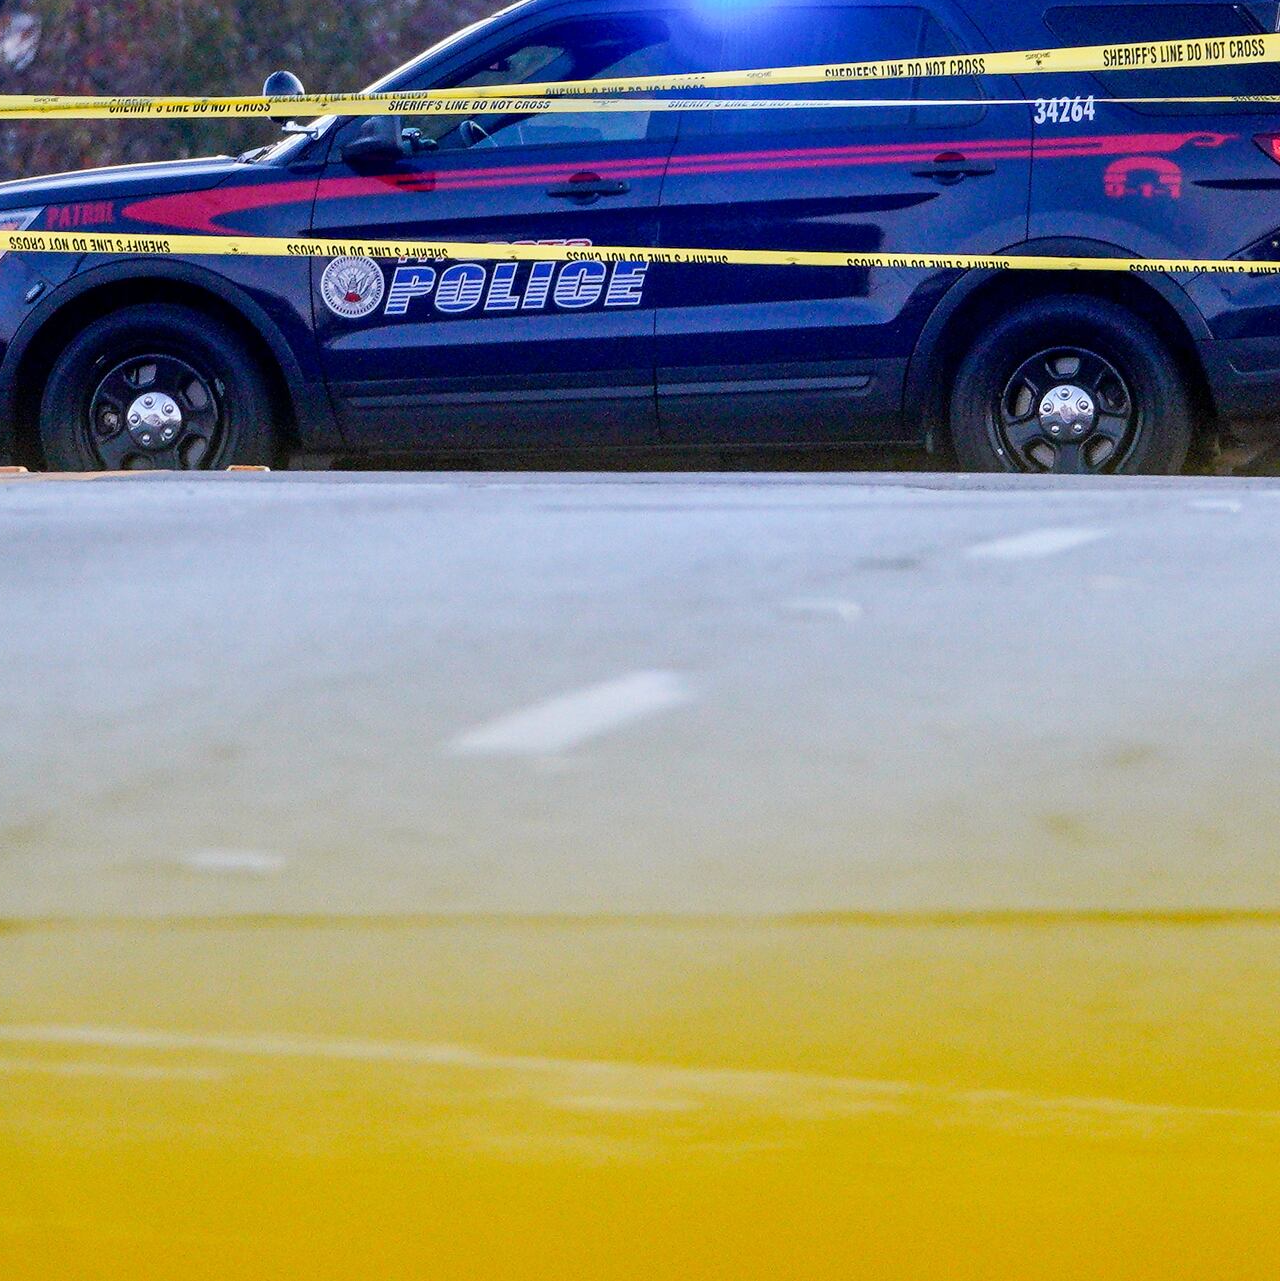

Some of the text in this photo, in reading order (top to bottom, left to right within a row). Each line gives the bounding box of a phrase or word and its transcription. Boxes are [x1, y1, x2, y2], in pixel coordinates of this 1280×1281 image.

[1102, 38, 1265, 67] SHERIFF'S LINE DO NOT CROSS
[950, 58, 986, 76] CROSS
[387, 100, 442, 111] SHERIFF'S
[444, 100, 469, 110] LINE
[489, 100, 511, 110] NOT
[514, 100, 550, 110] CROSS
[1033, 96, 1096, 125] 34264
[45, 202, 116, 229] PATROL
[8, 236, 171, 253] SHERIFF'S LINE DO NOT CROSS
[383, 260, 650, 316] POLICE
